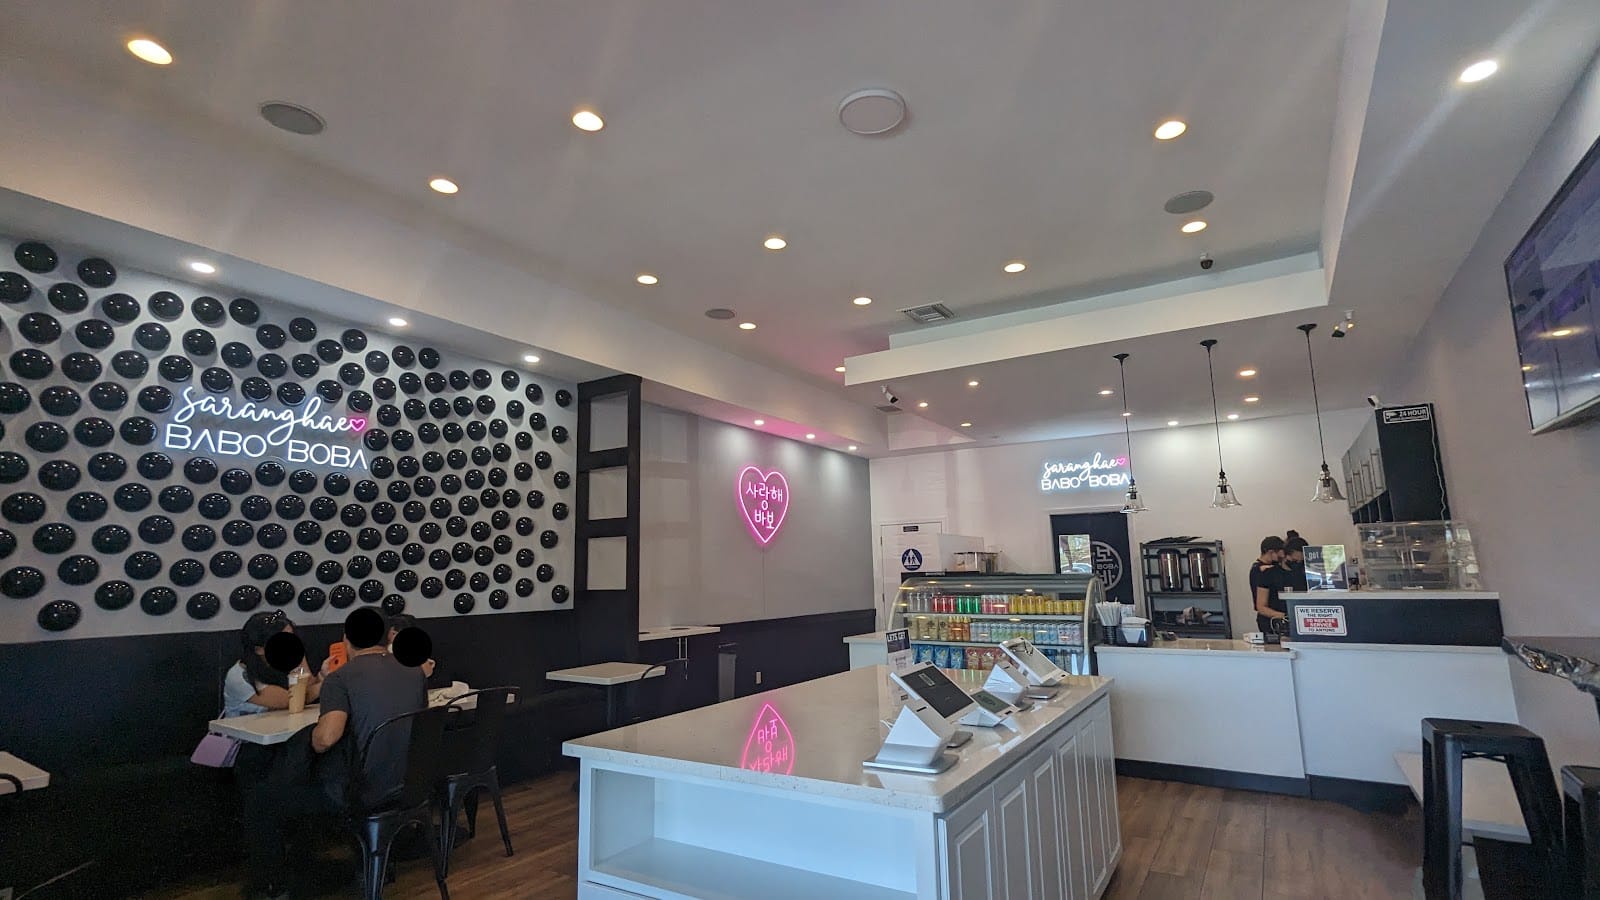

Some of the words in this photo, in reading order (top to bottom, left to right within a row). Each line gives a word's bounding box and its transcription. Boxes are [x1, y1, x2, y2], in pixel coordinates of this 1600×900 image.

[174, 386, 350, 446] saranghae
[1408, 409, 1427, 417] HOUR
[165, 423, 267, 458] BABO
[287, 439, 368, 470] BOBA
[1043, 452, 1117, 481] saranghae
[745, 481, 783, 511] 사랑해
[1041, 476, 1081, 490] BABO
[1088, 473, 1130, 487] BOBA
[754, 509, 775, 529] 바보
